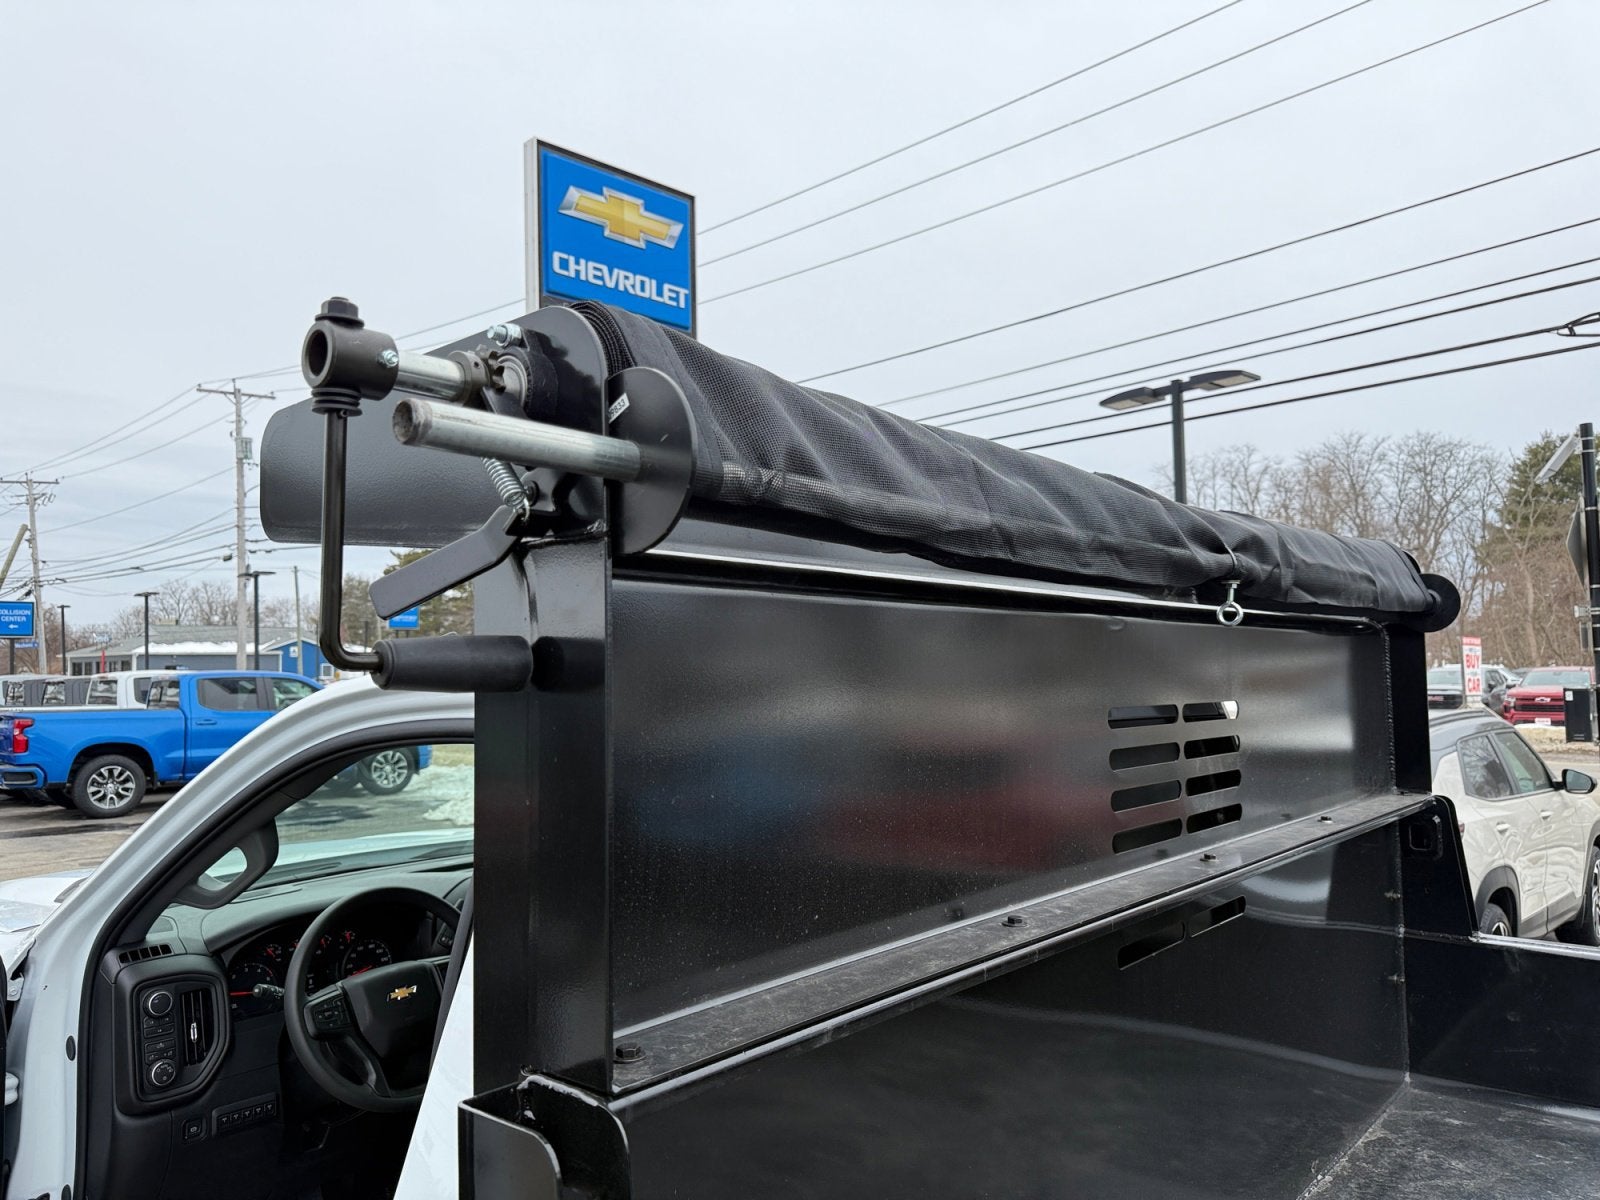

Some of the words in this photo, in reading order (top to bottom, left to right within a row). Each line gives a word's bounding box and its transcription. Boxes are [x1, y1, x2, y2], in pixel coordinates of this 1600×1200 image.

[552, 250, 690, 309] CHEVROLET
[1465, 654, 1480, 669] BUY
[1467, 677, 1481, 693] CAR
